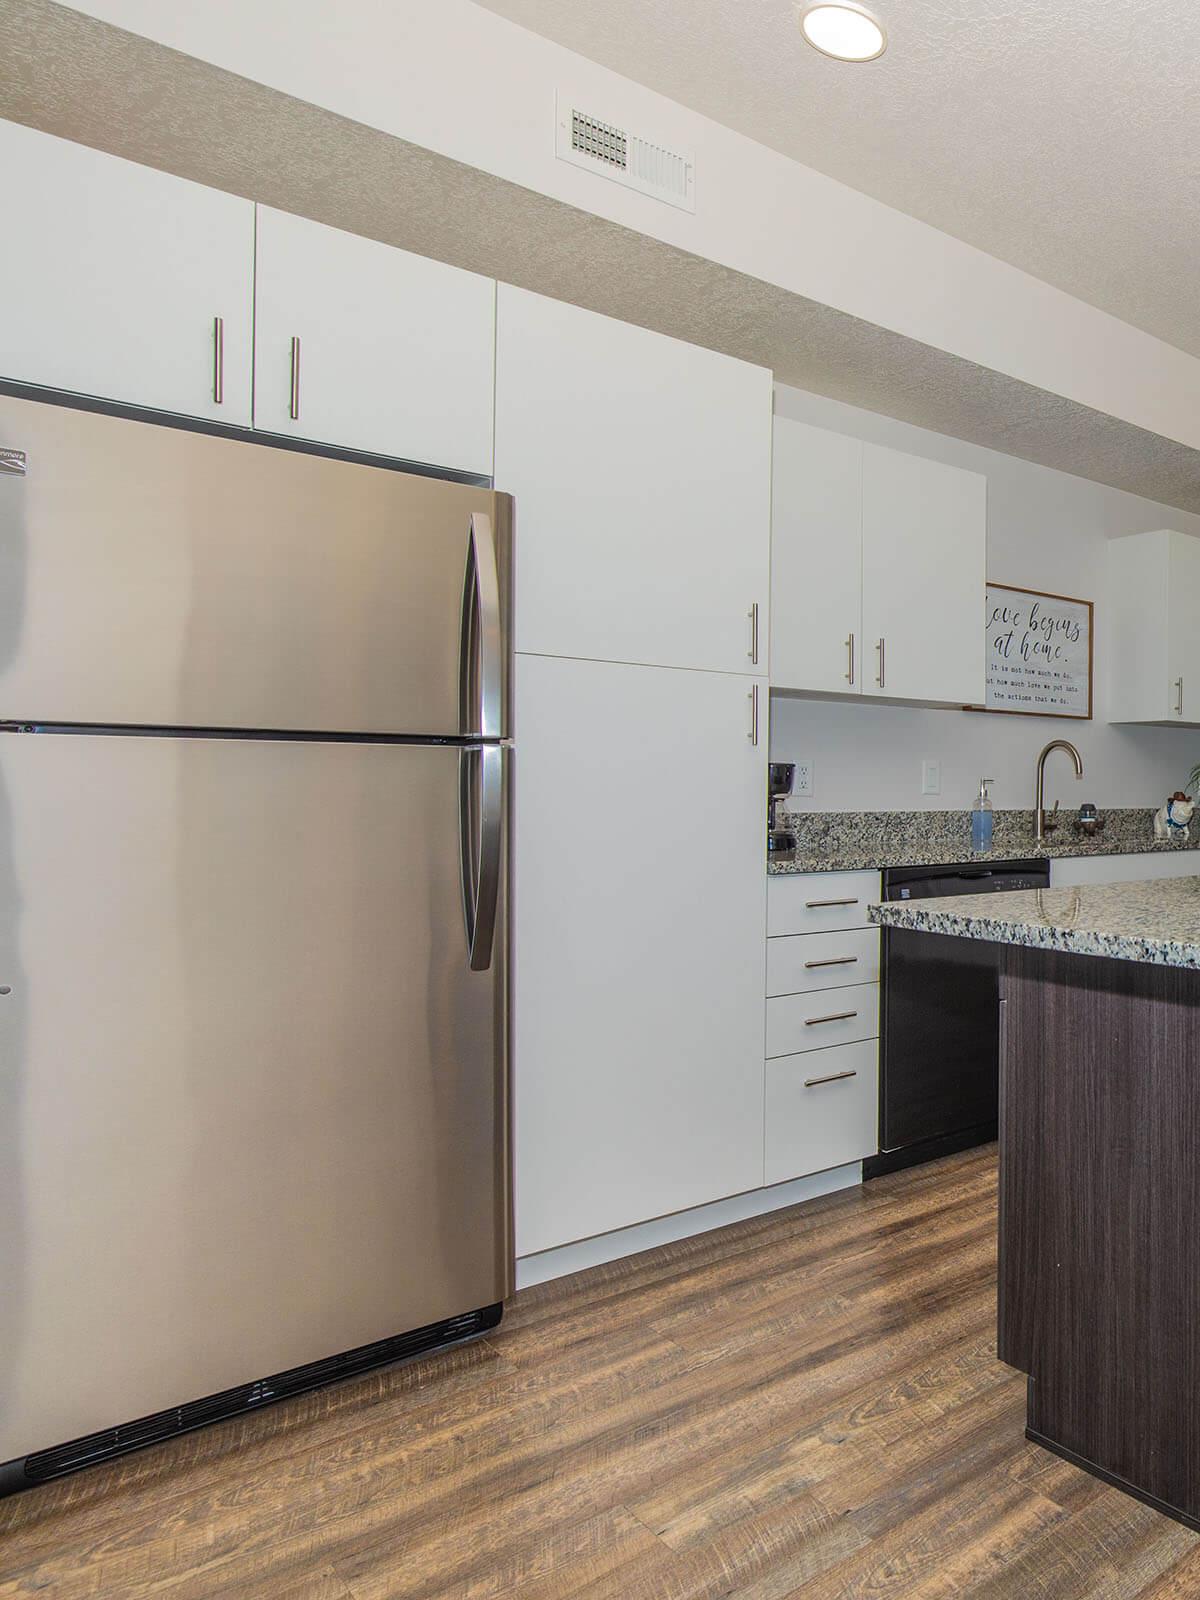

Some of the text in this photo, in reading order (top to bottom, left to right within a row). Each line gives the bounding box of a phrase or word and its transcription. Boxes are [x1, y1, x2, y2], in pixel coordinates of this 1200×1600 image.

[986, 596, 1080, 642] ove begins
[994, 630, 1070, 662] at home.
[1001, 664, 1009, 672] is
[1011, 666, 1022, 674] not
[1024, 667, 1036, 675] how
[1027, 681, 1041, 689] love
[1053, 684, 1063, 692] put
[994, 691, 1005, 699] the
[1034, 695, 1048, 703] that
